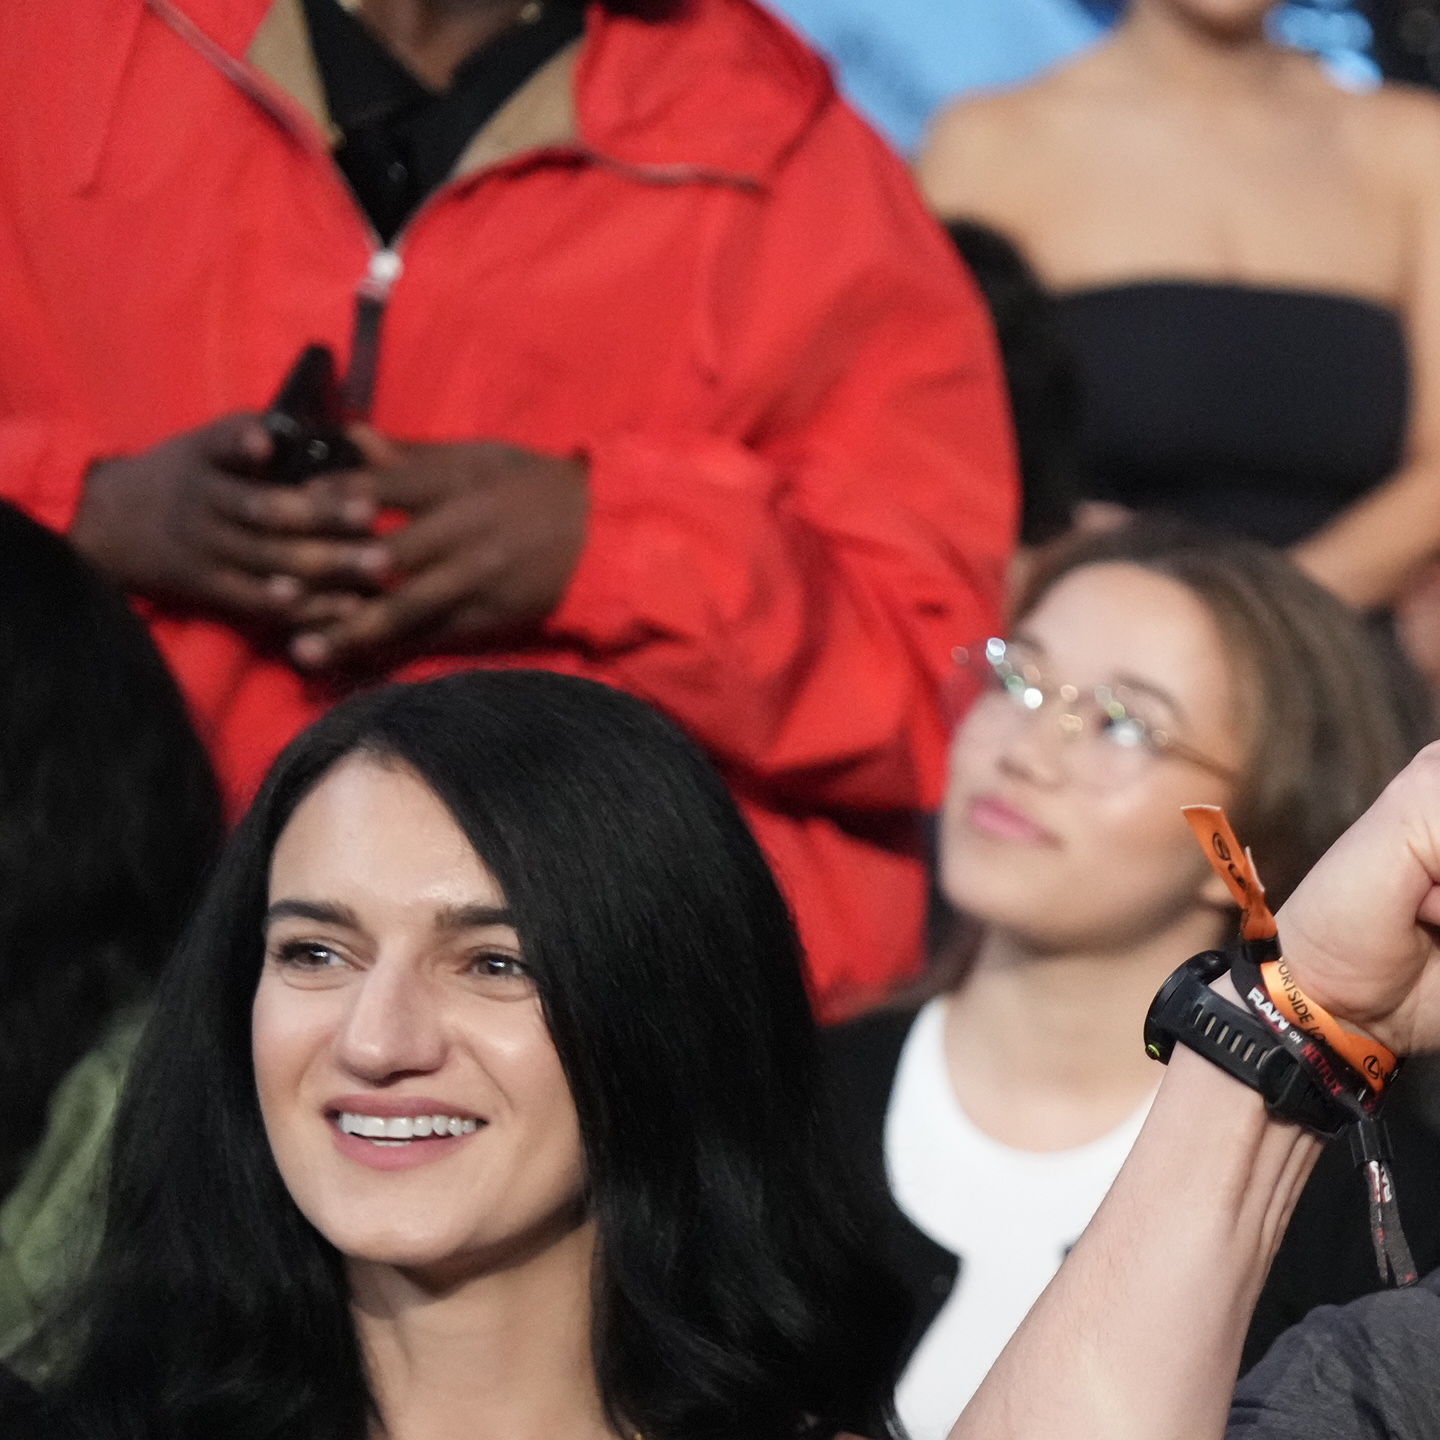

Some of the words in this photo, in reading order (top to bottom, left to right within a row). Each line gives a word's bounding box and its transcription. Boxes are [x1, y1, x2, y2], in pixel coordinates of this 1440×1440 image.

[1247, 987, 1290, 1031] RAW
[1289, 1030, 1303, 1045] ON
[1301, 1043, 1344, 1097] NETFLIX
